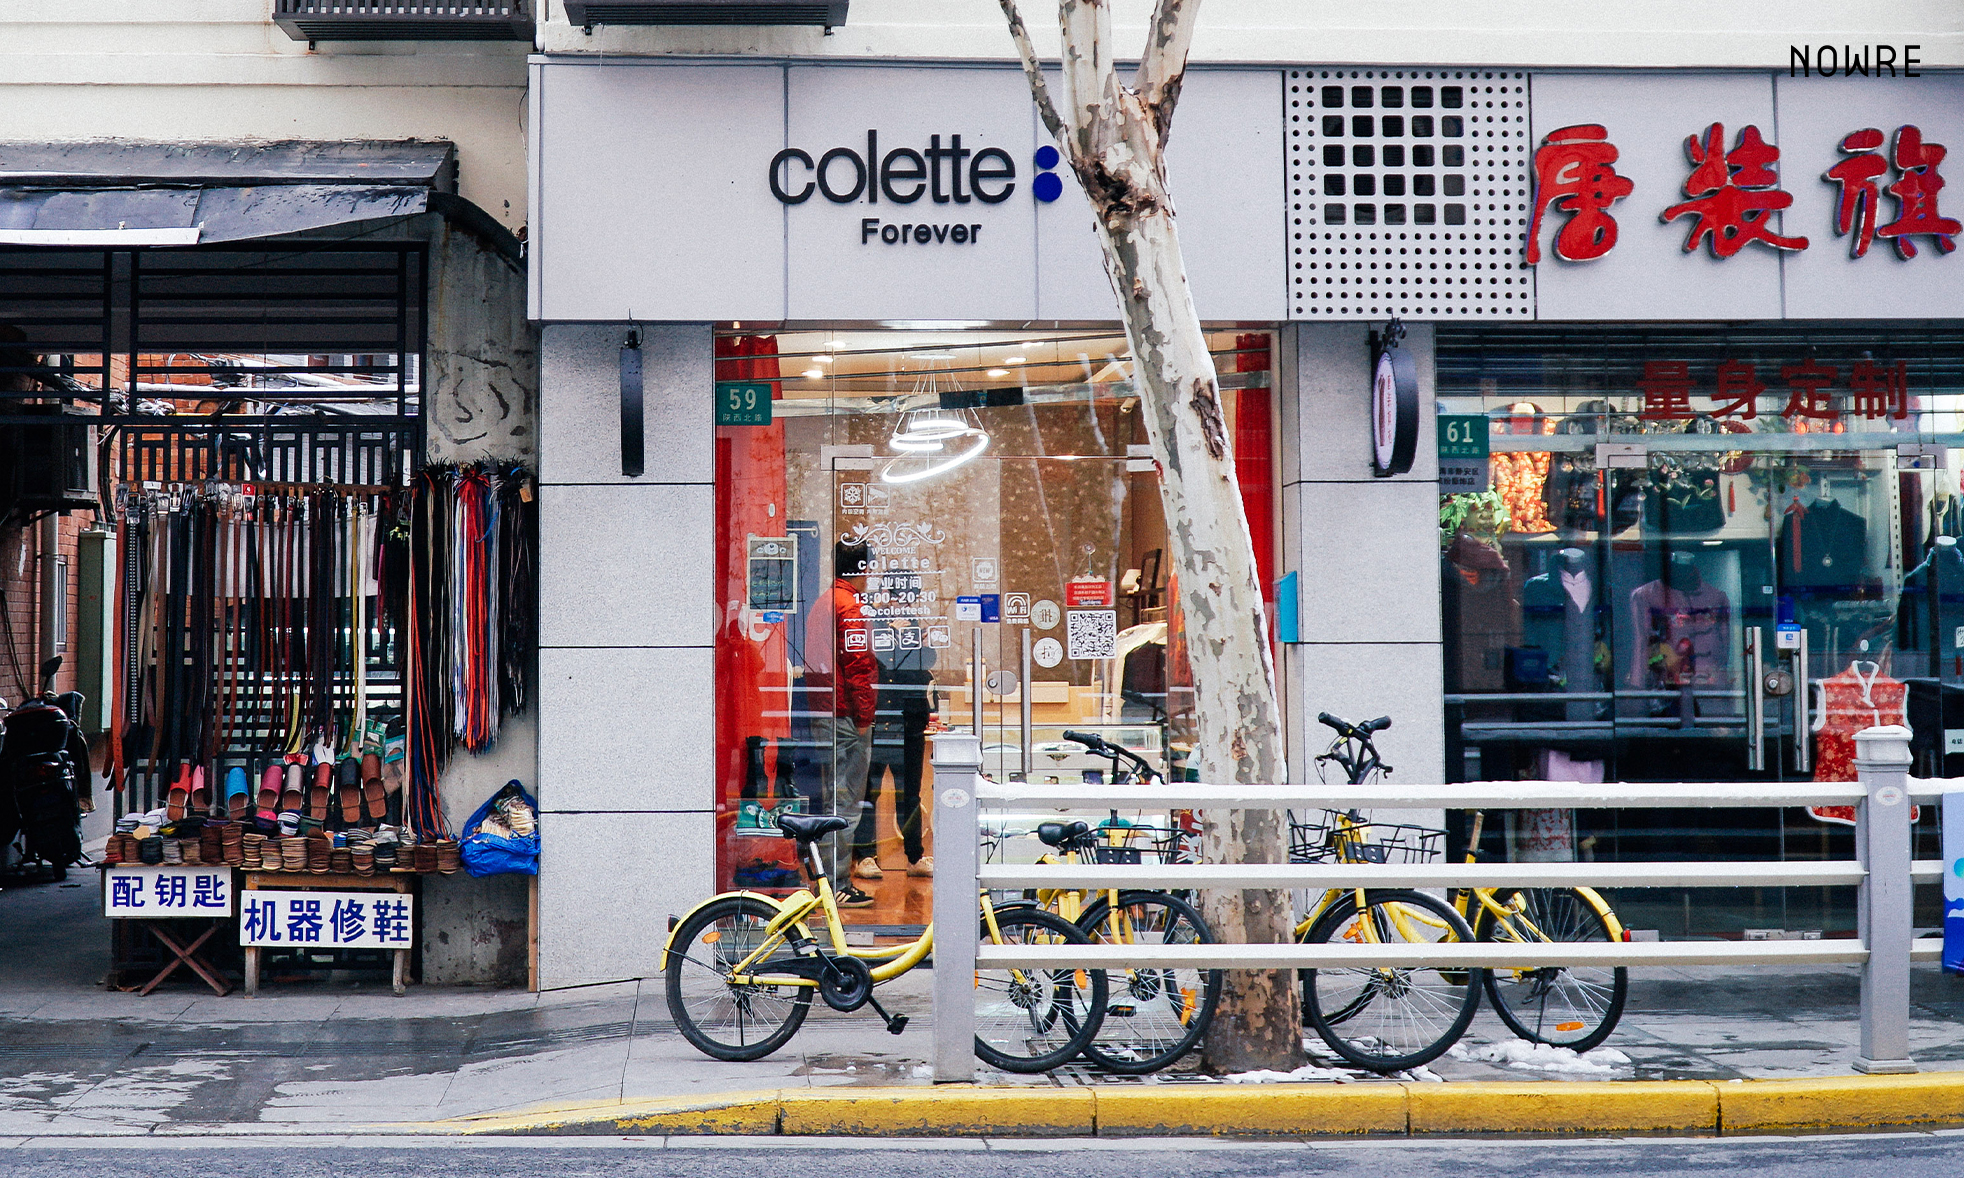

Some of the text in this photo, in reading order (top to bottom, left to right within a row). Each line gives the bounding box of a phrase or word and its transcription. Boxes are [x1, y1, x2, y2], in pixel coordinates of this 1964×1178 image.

[769, 129, 1016, 205] colette
[861, 217, 982, 245] Forever
[729, 388, 757, 410] 59
[1635, 358, 1908, 421] 量身定制
[1446, 421, 1474, 443] 61
[871, 546, 917, 555] WELCOME
[857, 556, 931, 571] colette
[866, 576, 923, 590] 营业时间
[852, 590, 937, 604] 13:00~20:30
[877, 604, 931, 616] colettesh
[111, 873, 226, 909] 配钥匙
[243, 898, 410, 943] 机器修鞋
